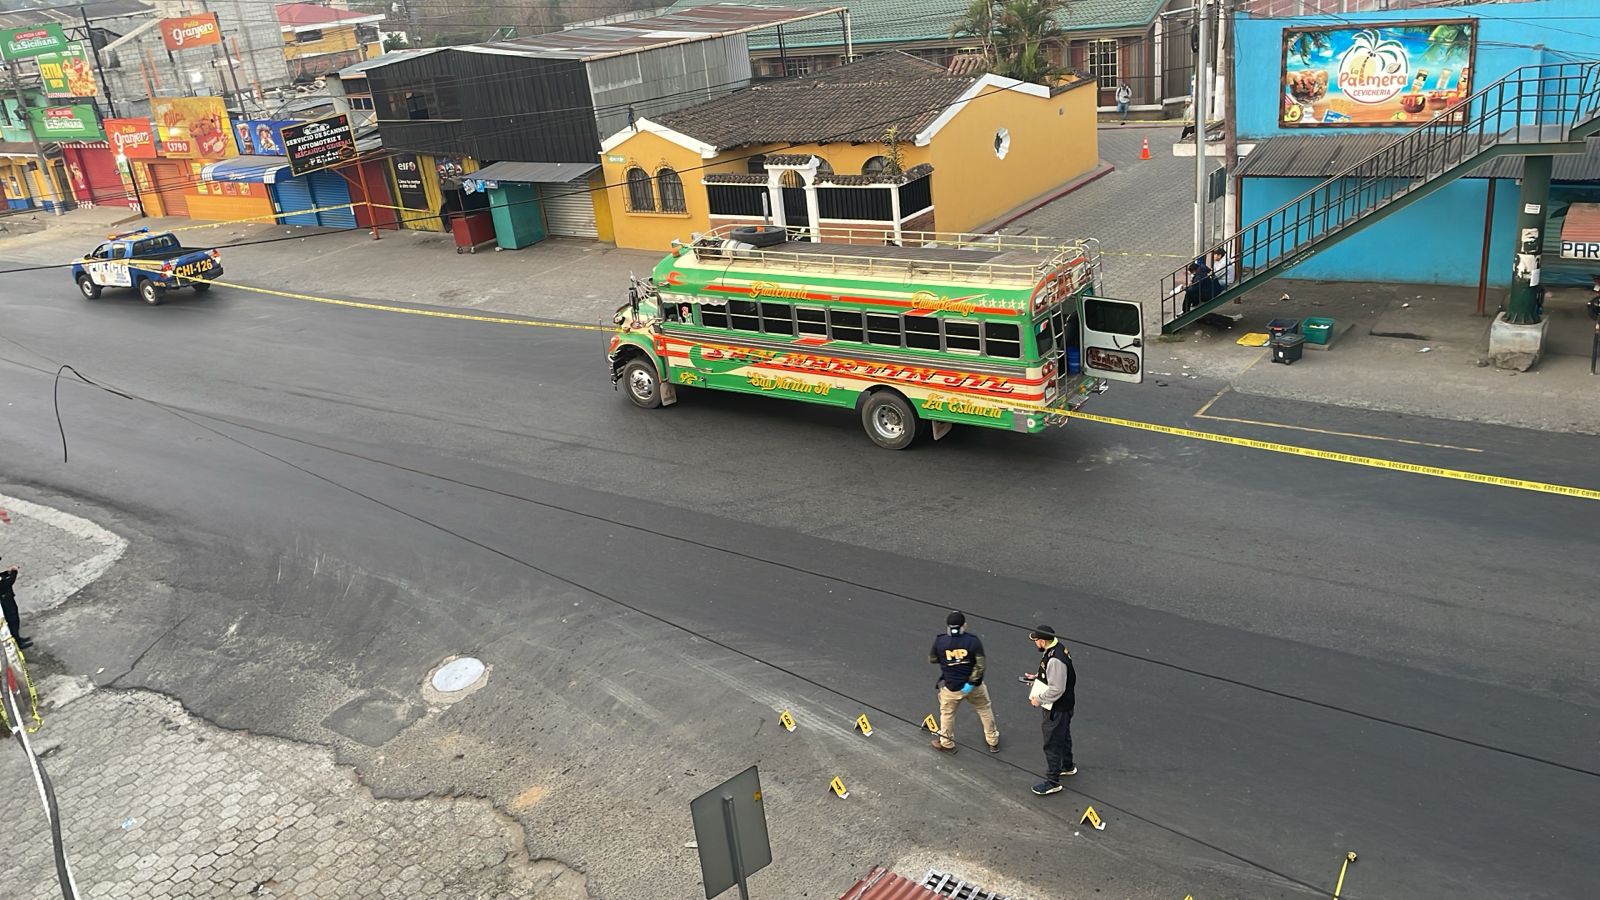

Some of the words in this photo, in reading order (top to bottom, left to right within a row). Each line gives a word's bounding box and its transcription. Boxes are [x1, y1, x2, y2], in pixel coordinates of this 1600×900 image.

[1339, 72, 1407, 88] Palmera
[1353, 89, 1390, 97] CEVICHERIA
[286, 134, 314, 146] SERVICIO
[323, 126, 350, 136] SCANNER
[298, 137, 336, 152] AUTOMOTRIZ
[398, 162, 408, 170] elf
[176, 258, 213, 277] CHI-126
[749, 280, 809, 300] Guatemala
[922, 393, 944, 412] La
[948, 396, 1002, 419] Estancia
[945, 648, 968, 660] MP
[860, 718, 868, 730] 5
[834, 780, 842, 790] 4
